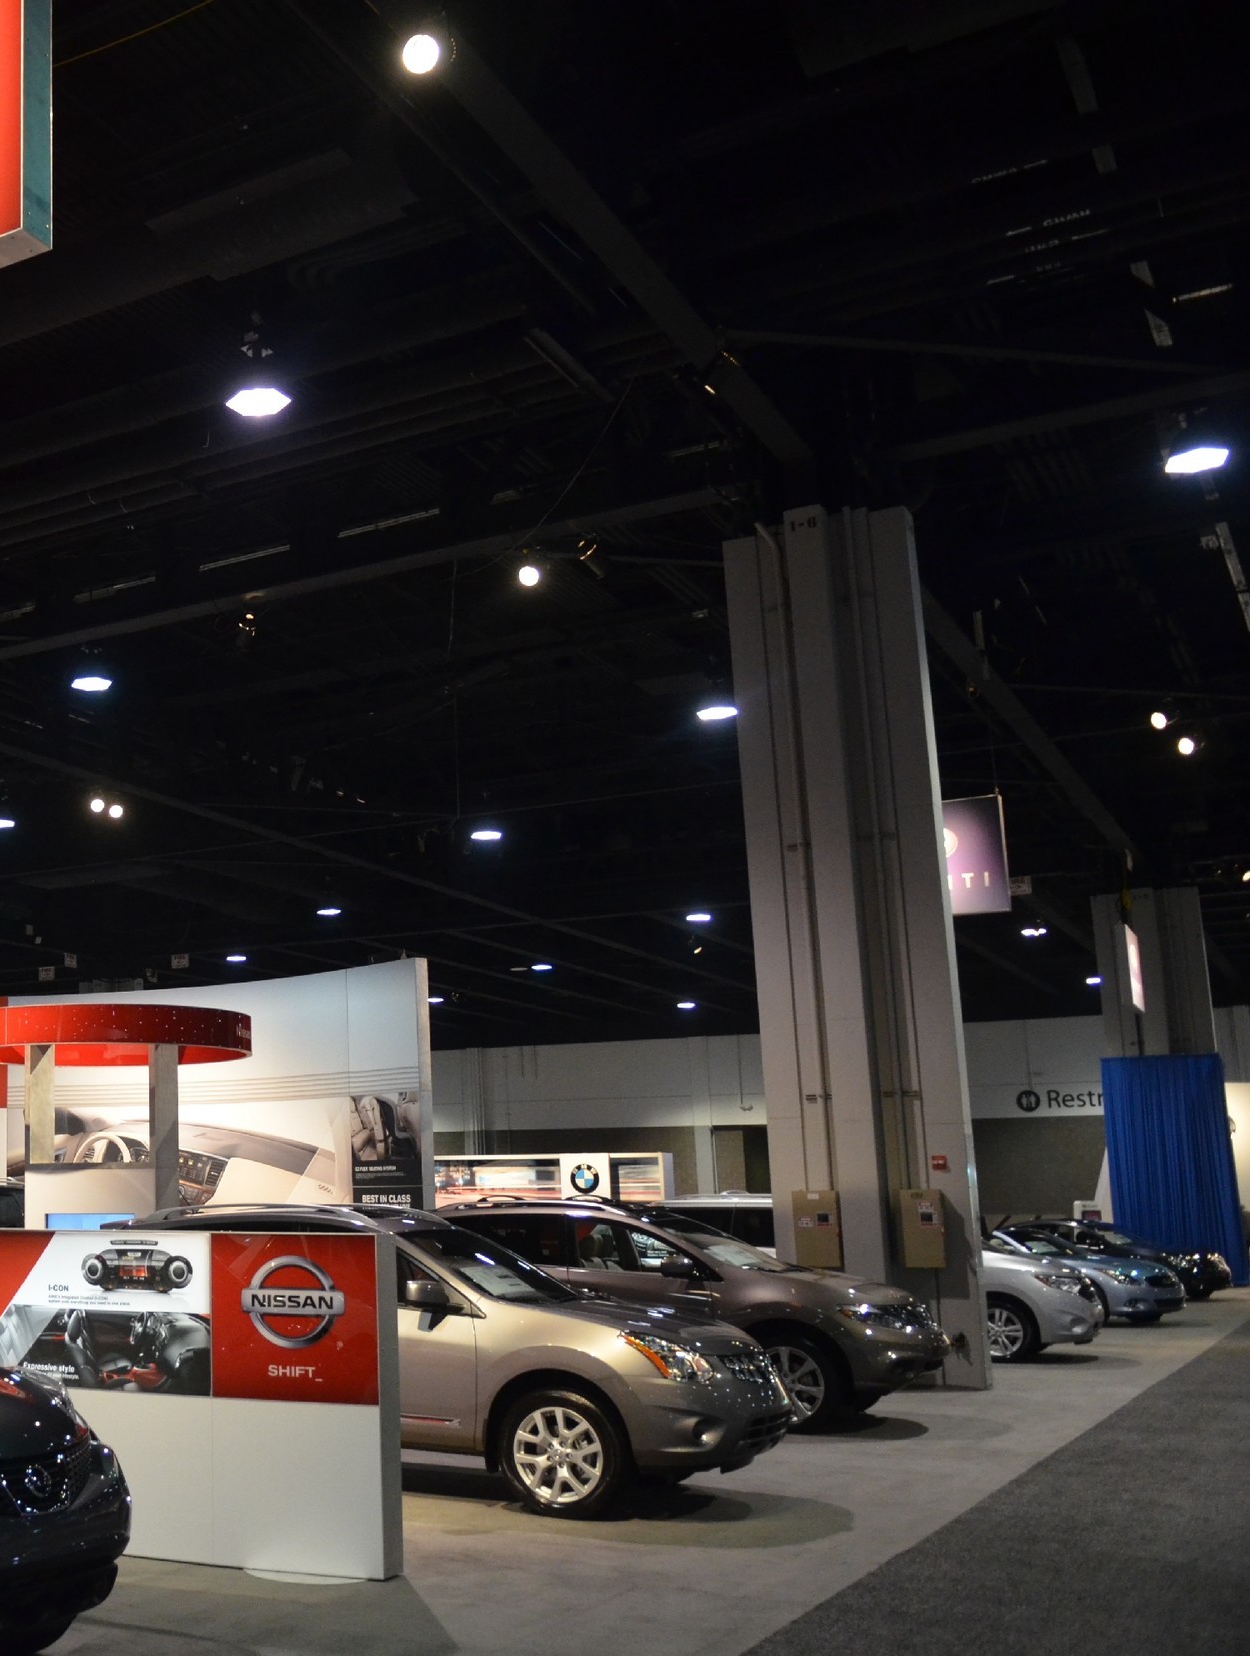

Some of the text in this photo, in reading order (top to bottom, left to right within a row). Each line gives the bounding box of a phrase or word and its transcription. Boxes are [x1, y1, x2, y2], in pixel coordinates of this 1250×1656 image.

[362, 1194, 411, 1203] BEST IN CLASS
[48, 1284, 69, 1292] I-CON
[251, 1294, 334, 1309] NISSAN
[23, 1361, 75, 1373] Expressive style
